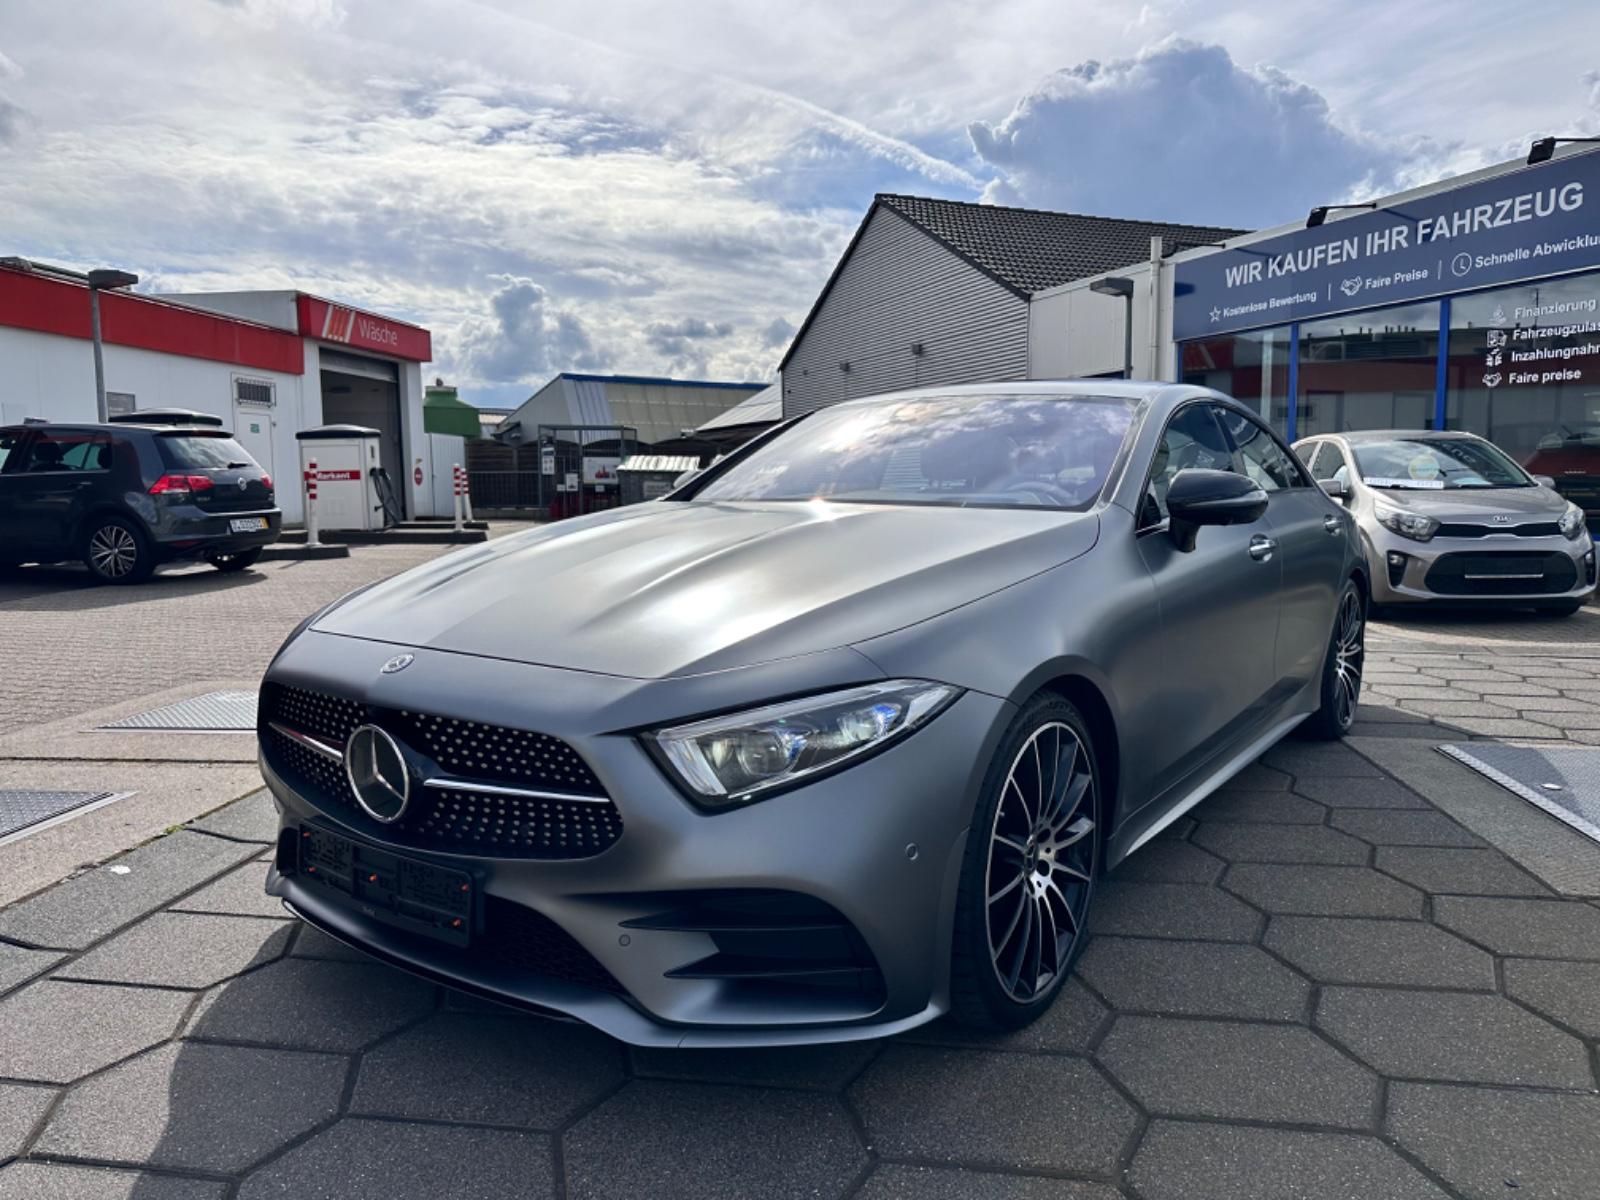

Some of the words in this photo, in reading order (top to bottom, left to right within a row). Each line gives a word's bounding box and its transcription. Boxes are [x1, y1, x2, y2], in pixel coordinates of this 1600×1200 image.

[1225, 261, 1262, 288] WIR
[1267, 236, 1358, 279] KAUFEN
[1366, 225, 1409, 256] IHR
[1416, 182, 1584, 245] FAHRZEUG
[1475, 248, 1530, 268] Schnelle
[1533, 234, 1600, 257] Abwicklu
[1365, 277, 1391, 290] Faire
[1394, 269, 1429, 284] Preise
[1223, 302, 1268, 318] Kostenlose
[1269, 292, 1317, 309] Bewertung
[1515, 299, 1596, 319] Finanzierung
[358, 319, 398, 345] Wäsche
[1509, 373, 1538, 385] Faire
[1542, 368, 1582, 384] preise
